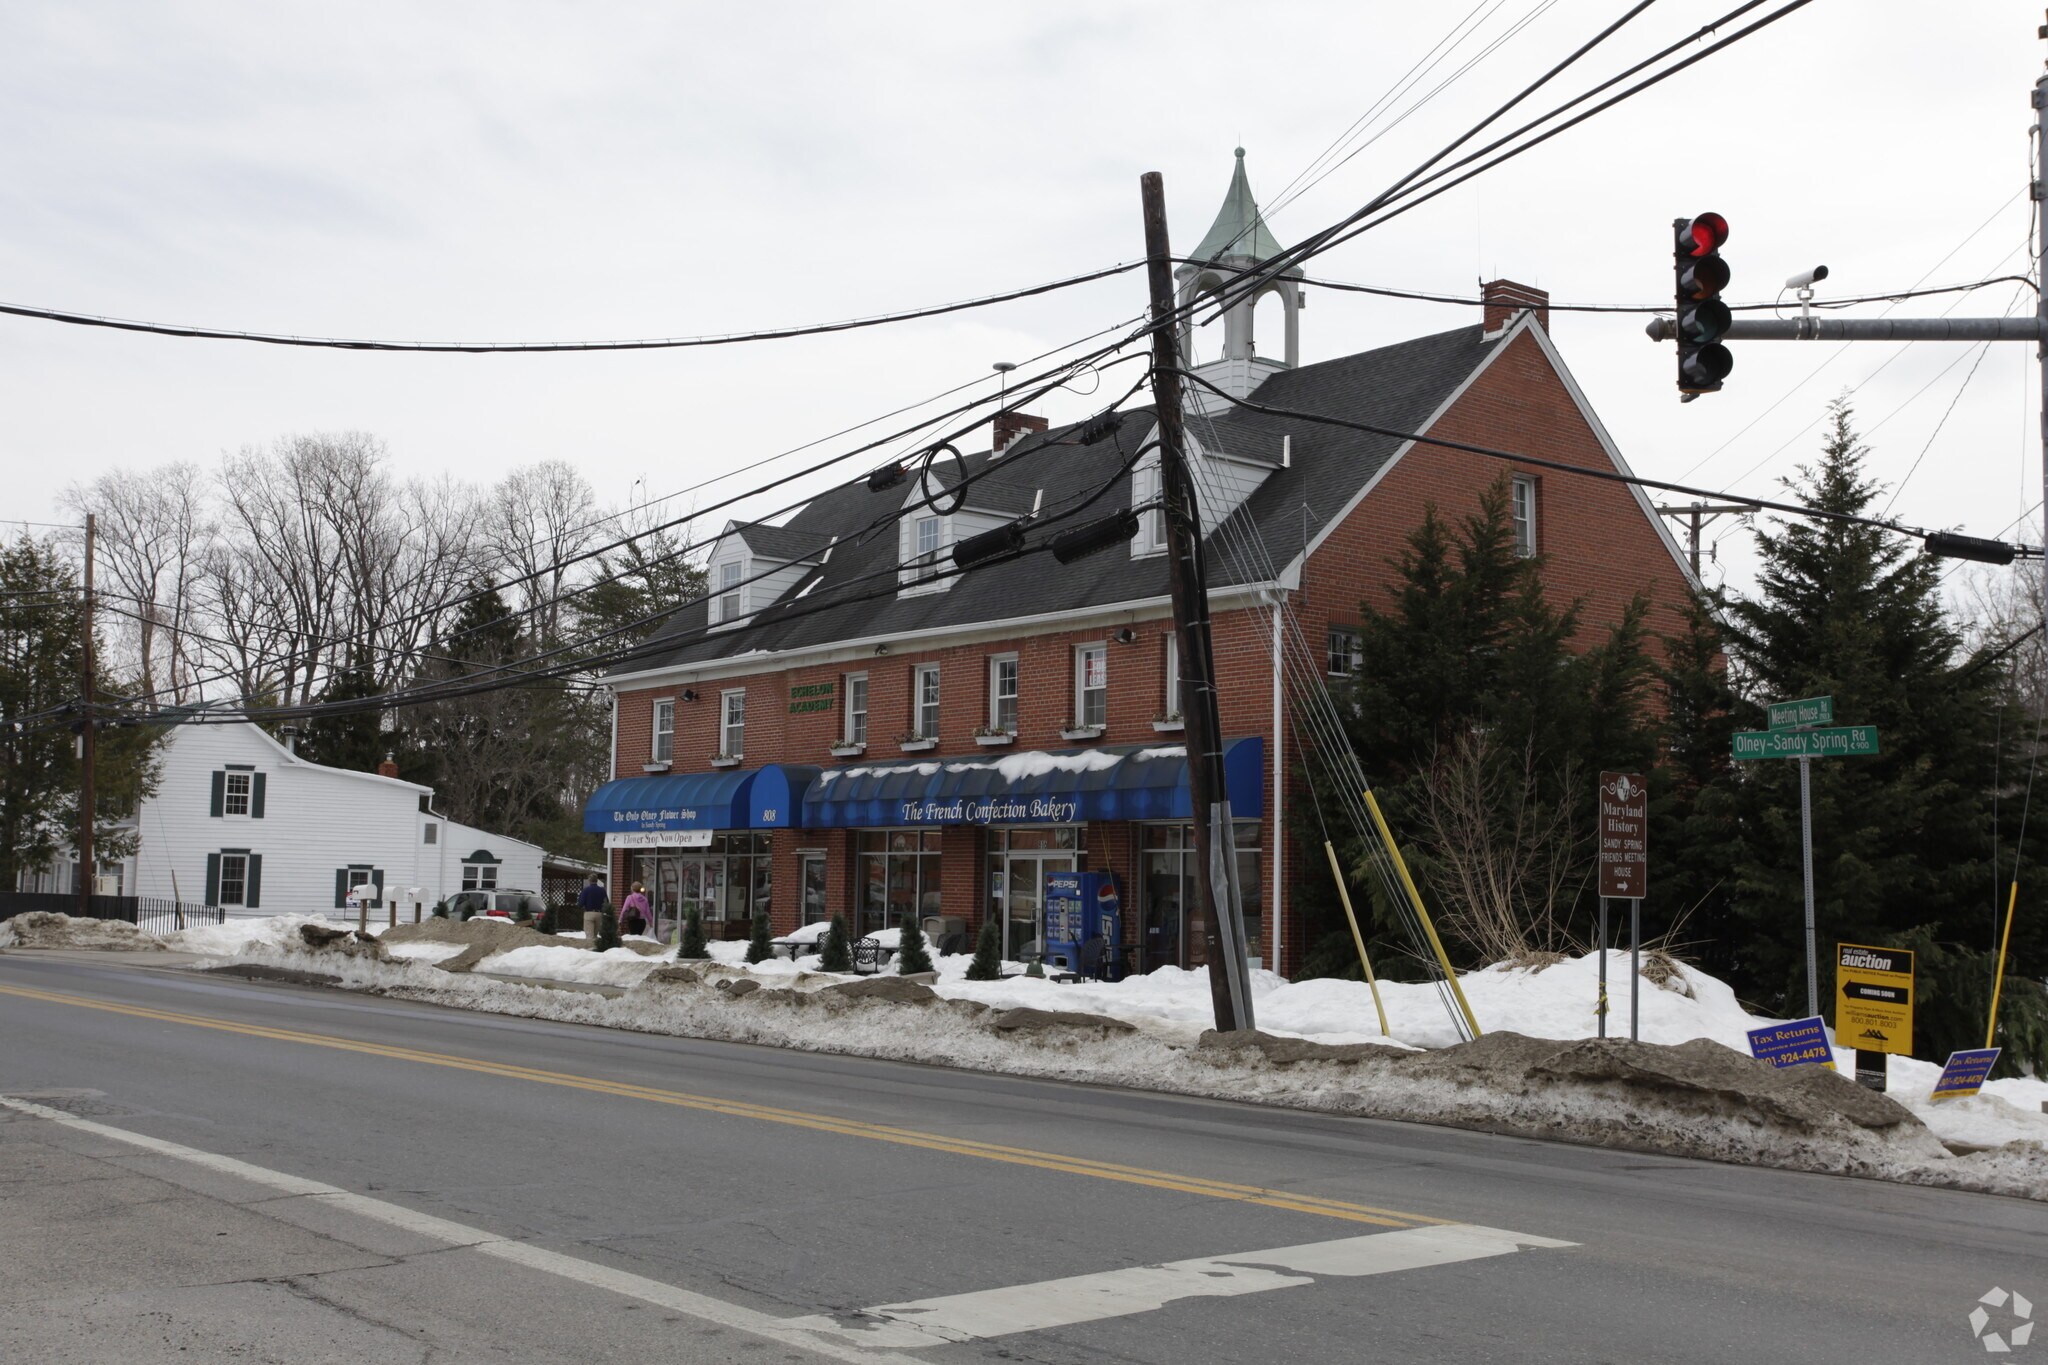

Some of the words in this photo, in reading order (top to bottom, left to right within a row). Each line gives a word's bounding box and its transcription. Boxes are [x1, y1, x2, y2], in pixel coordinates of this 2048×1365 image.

[1089, 674, 1106, 686] LEAS
[791, 683, 833, 699] ECHELON
[789, 698, 833, 713] ACADEMY
[1771, 707, 1797, 726] Meeting
[1799, 704, 1818, 721] House
[1820, 701, 1828, 712] Rd
[1736, 732, 1807, 755] Olney-Sandy
[1812, 731, 1848, 753] Spring
[1852, 729, 1866, 742] Rd
[1856, 741, 1870, 750] 900
[613, 811, 624, 822] The
[626, 810, 639, 822] Only
[641, 810, 657, 822] Olney
[659, 809, 680, 822] Flower
[681, 808, 697, 821] Shop
[762, 809, 777, 822] 808
[902, 801, 922, 821] The
[926, 799, 963, 820] French
[966, 798, 1026, 824] Confection
[1030, 796, 1076, 823] Bakery
[1603, 802, 1643, 820] Maryland
[1608, 818, 1638, 836] History
[623, 834, 643, 845] Flower
[659, 833, 673, 843] Now
[674, 832, 692, 845] Open
[1604, 838, 1621, 849] SANDY
[1624, 839, 1643, 850] SPRING
[1601, 852, 1622, 862] FRIENDS
[1624, 852, 1646, 862] MEETING
[1613, 867, 1632, 877] HOUSE
[1053, 880, 1079, 889] PEPSI
[1841, 954, 1892, 971] auction
[1860, 987, 1880, 996] COMING
[1880, 989, 1895, 998] SOON
[1752, 1035, 1773, 1045] Tax
[1776, 1026, 1820, 1040] Returns
